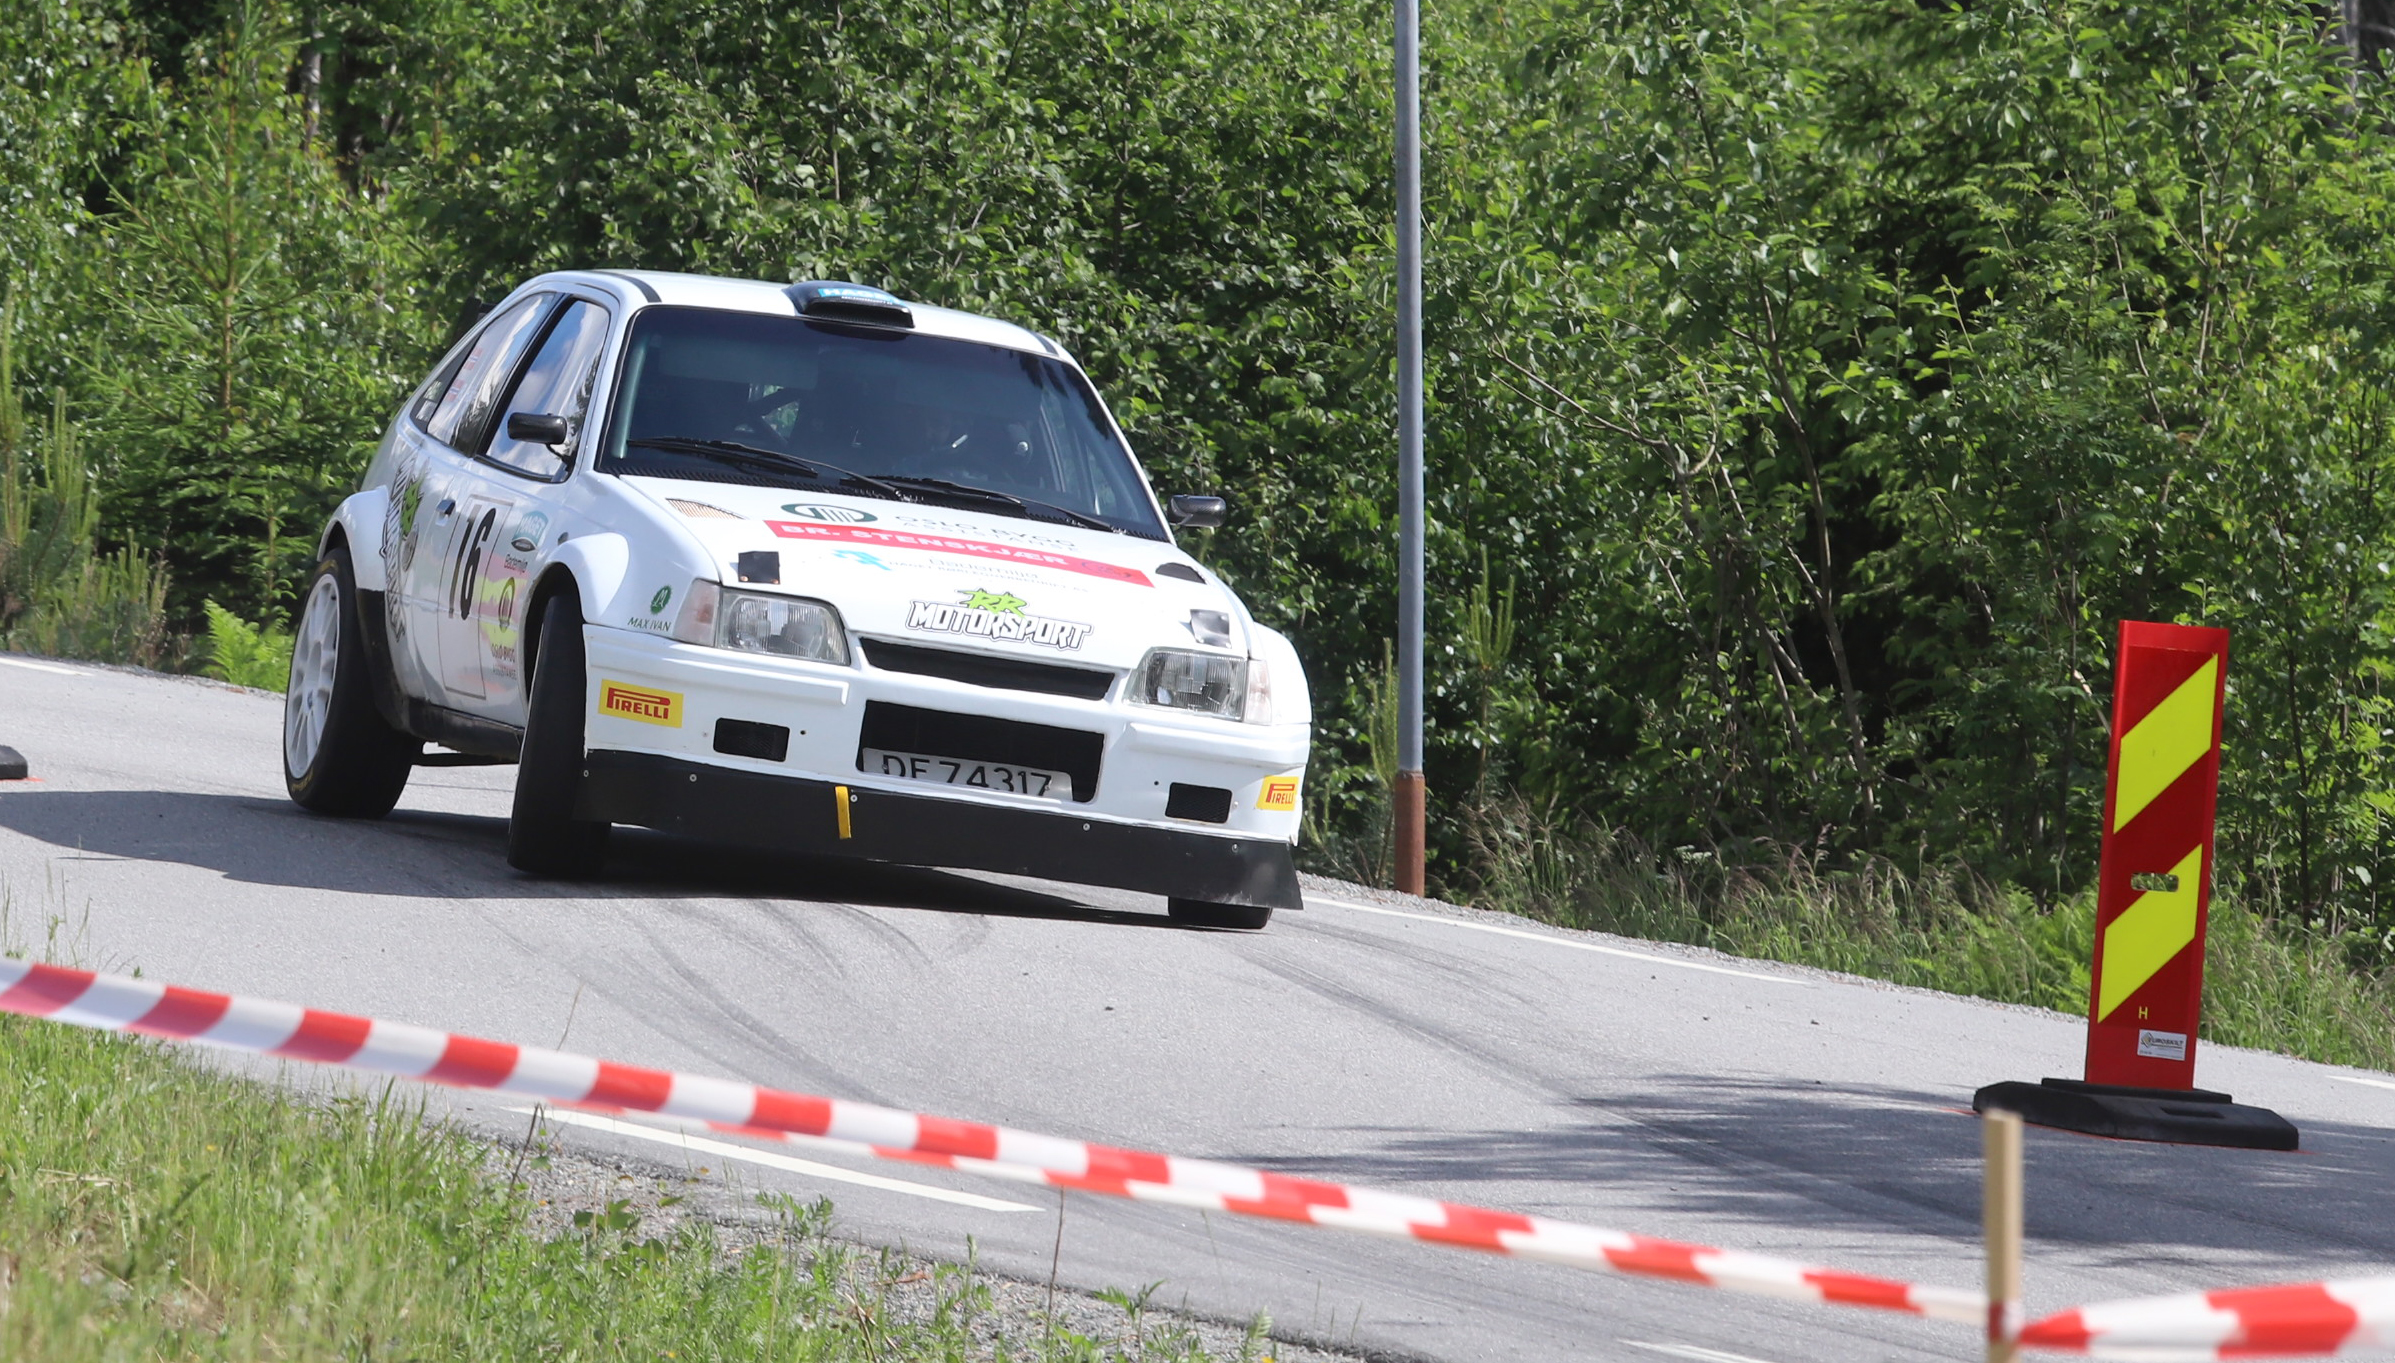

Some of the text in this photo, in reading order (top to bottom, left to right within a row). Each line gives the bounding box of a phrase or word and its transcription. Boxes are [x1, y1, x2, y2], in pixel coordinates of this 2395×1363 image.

[448, 503, 496, 621] 16
[780, 524, 1069, 566] BR. STENSKJÆR
[628, 617, 672, 631] MAX IVAN
[907, 600, 1092, 649] MOTORSPORT
[606, 687, 671, 720] PIRELLI
[939, 760, 1052, 796] 74317
[1265, 783, 1296, 804] PIRELLI
[2138, 1006, 2148, 1020] H
